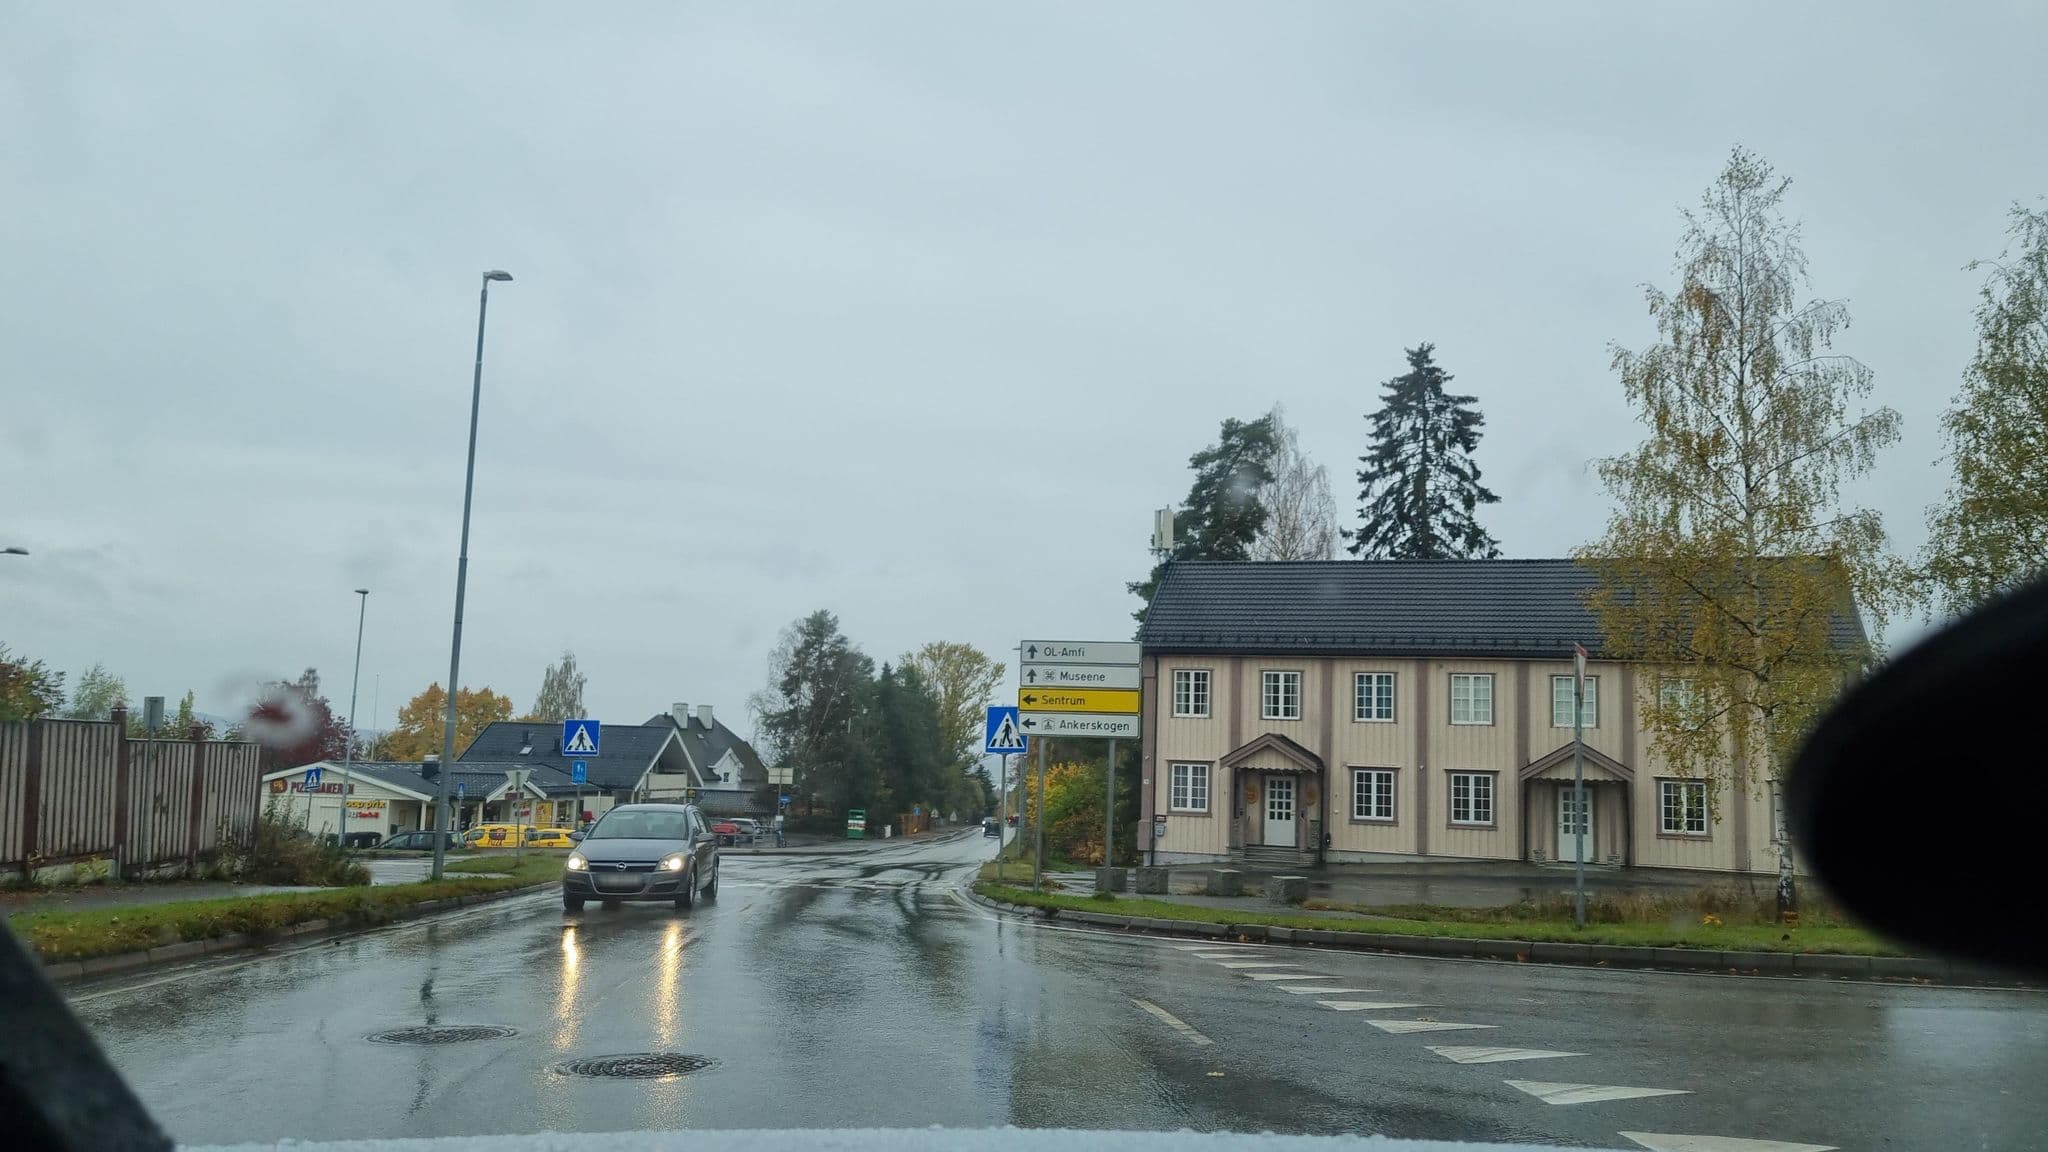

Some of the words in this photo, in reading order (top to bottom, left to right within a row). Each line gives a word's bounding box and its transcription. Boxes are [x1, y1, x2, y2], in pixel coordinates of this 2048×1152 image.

[1043, 646, 1086, 657] OL-Amfi
[1060, 671, 1106, 682] Museene
[1041, 695, 1086, 705] Sentrum
[1059, 720, 1130, 733] Ankerskogen
